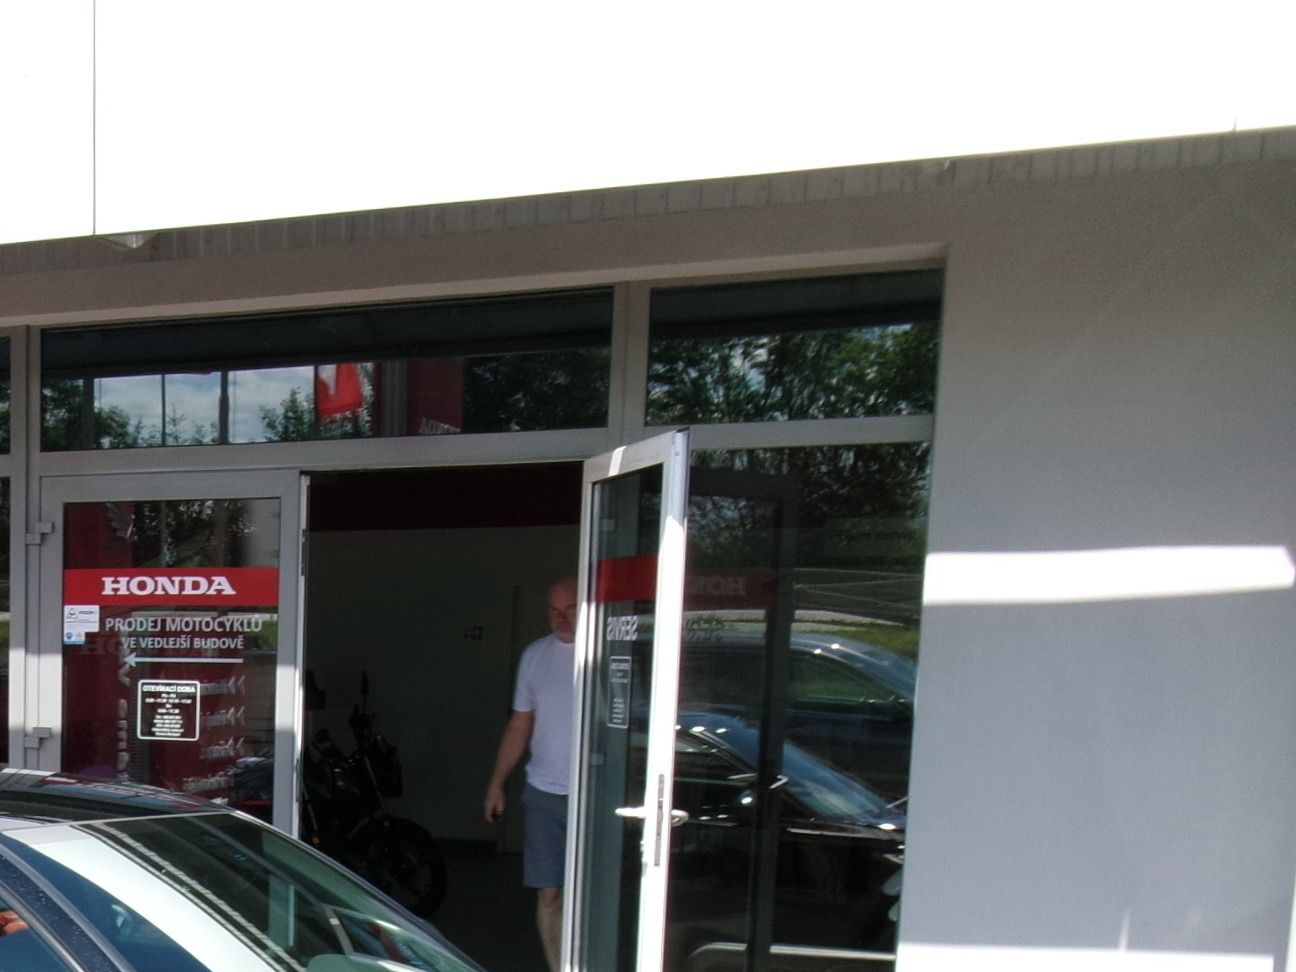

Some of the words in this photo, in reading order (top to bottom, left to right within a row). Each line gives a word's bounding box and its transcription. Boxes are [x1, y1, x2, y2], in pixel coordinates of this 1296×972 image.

[101, 576, 236, 595] HONDA
[105, 617, 161, 632] PRODEJ
[122, 637, 137, 649] VE
[140, 634, 191, 649] VEDLEJŠÍ
[193, 635, 244, 649] BUDOVĚ
